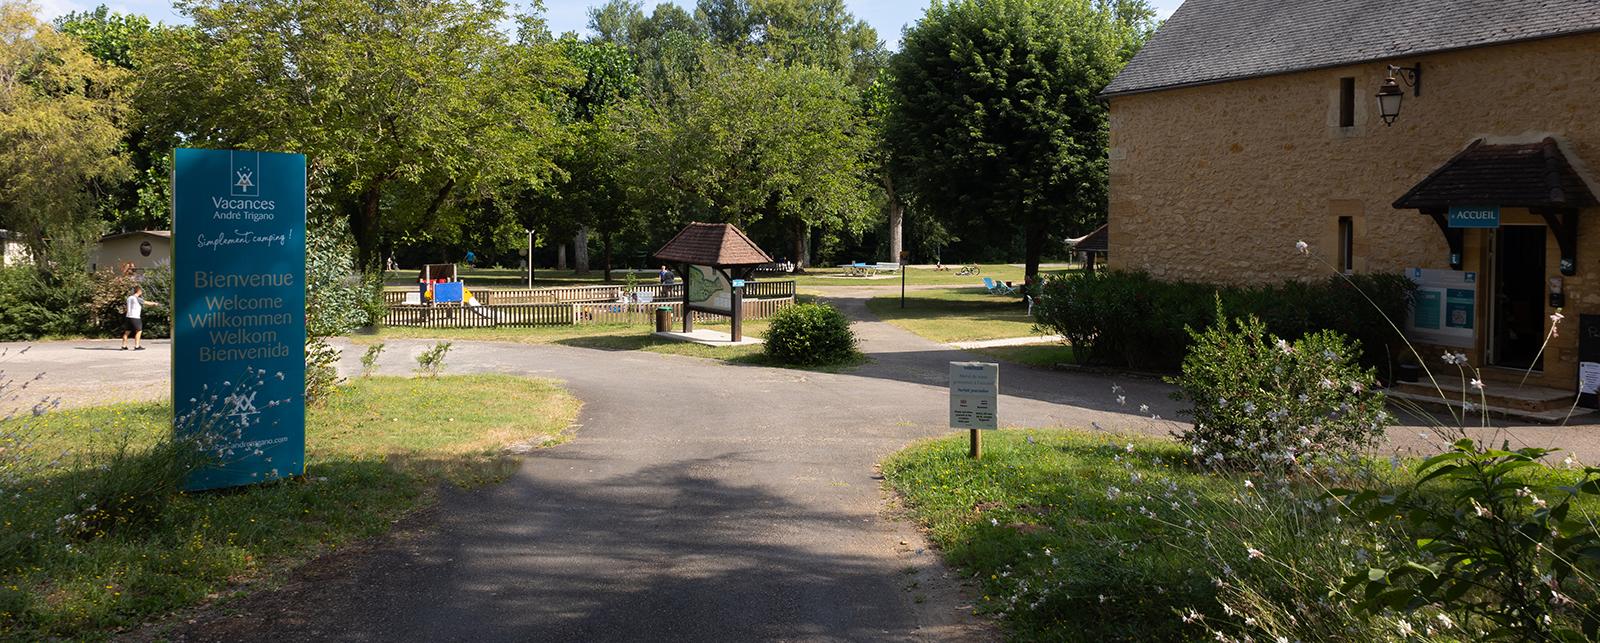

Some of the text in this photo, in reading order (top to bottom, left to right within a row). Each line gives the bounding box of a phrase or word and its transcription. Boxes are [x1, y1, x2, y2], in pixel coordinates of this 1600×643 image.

[212, 196, 275, 210] Vacances
[213, 211, 275, 222] André Trigano
[1456, 210, 1496, 220] ACCUEIL
[197, 230, 253, 251] Simplement
[253, 234, 286, 247] camping
[194, 271, 294, 288] Bienvenue
[205, 294, 283, 311] Welcome
[189, 312, 292, 328] Willkommen
[209, 329, 277, 345] Welkom
[199, 342, 289, 362] Bienvenida
